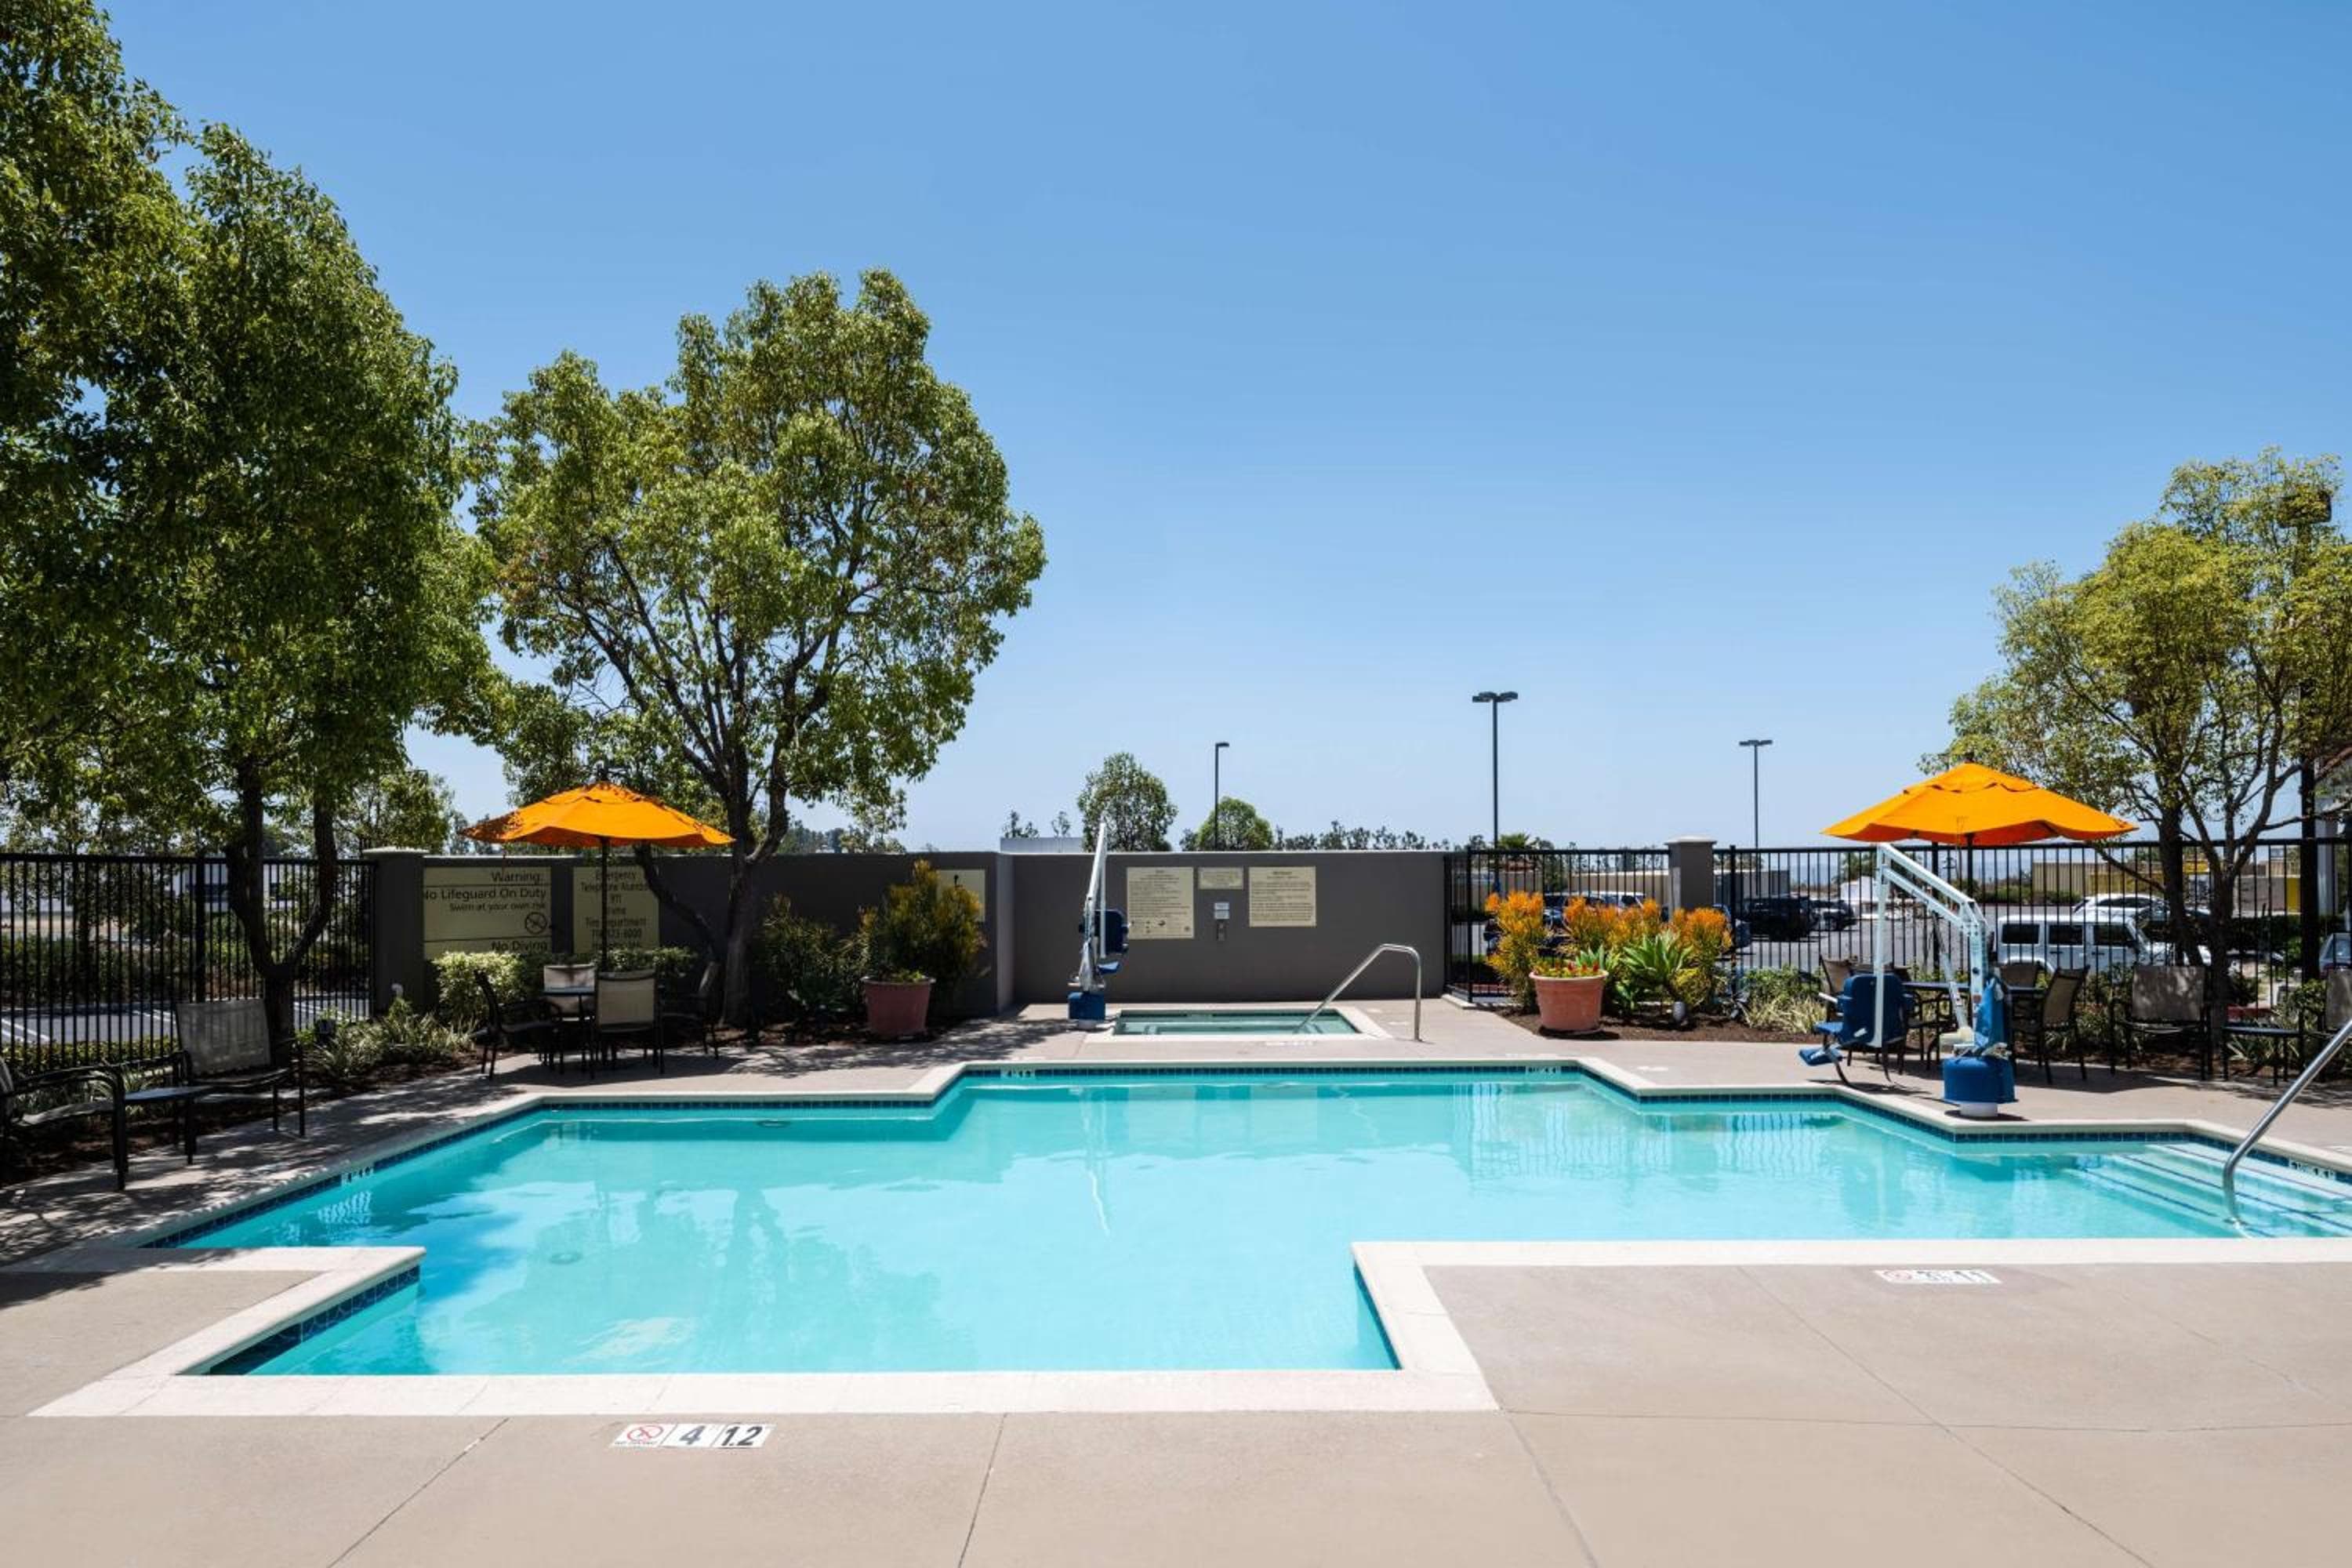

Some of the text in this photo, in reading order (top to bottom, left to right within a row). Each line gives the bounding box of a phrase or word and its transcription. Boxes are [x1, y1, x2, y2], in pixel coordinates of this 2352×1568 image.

[441, 888, 496, 902] Lifeguard
[499, 888, 517, 897] On
[520, 888, 546, 899] Duty
[491, 940, 508, 951] No
[679, 1425, 706, 1445] 4
